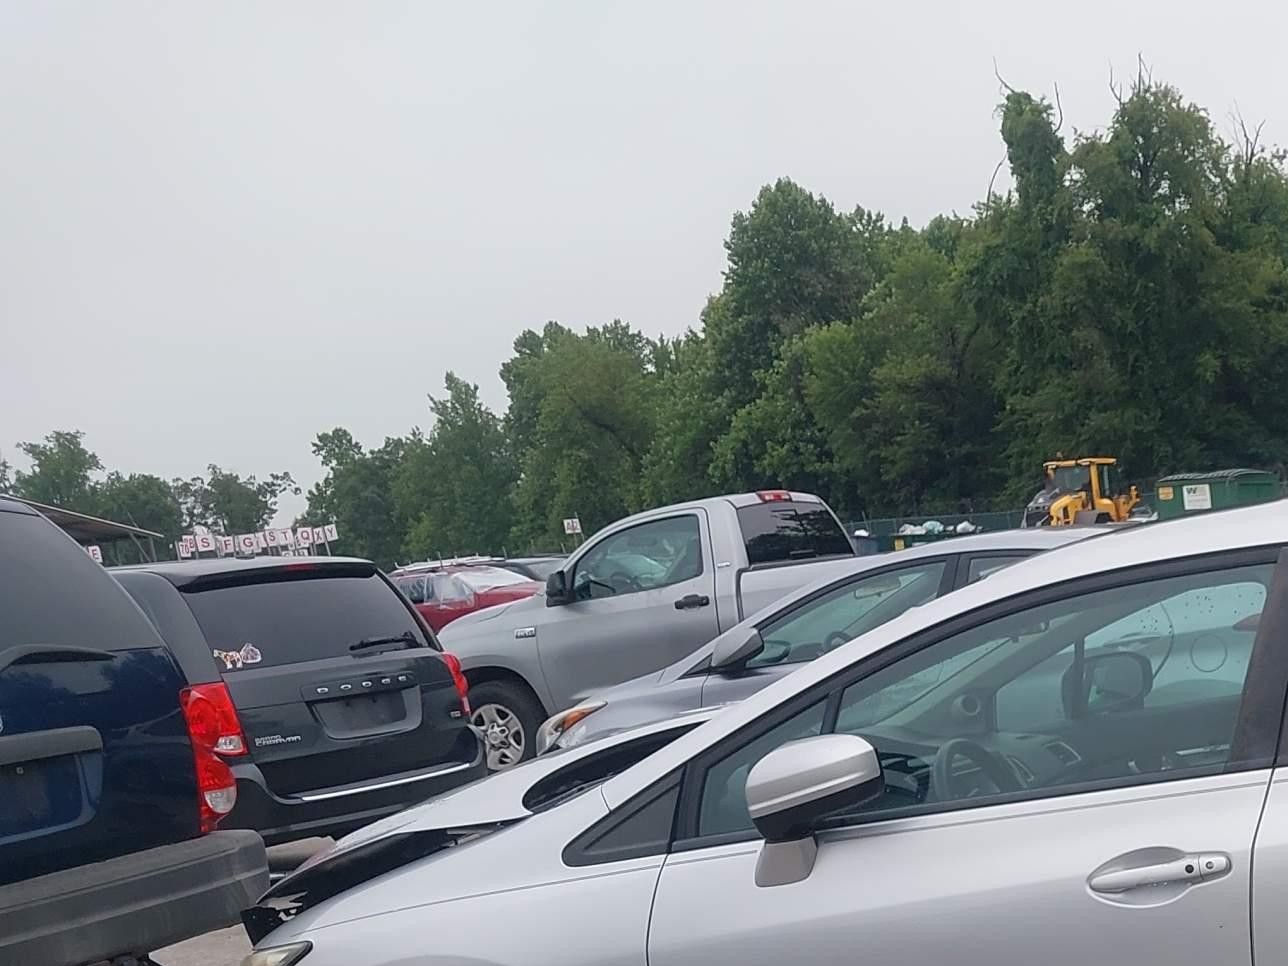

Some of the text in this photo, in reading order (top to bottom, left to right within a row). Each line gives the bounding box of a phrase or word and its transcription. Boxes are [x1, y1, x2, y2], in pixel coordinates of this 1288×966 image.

[281, 531, 289, 541] T
[326, 527, 334, 537] Y
[200, 537, 210, 548] S
[223, 540, 231, 550] F
[243, 537, 253, 548] G
[316, 675, 407, 694] DODGE
